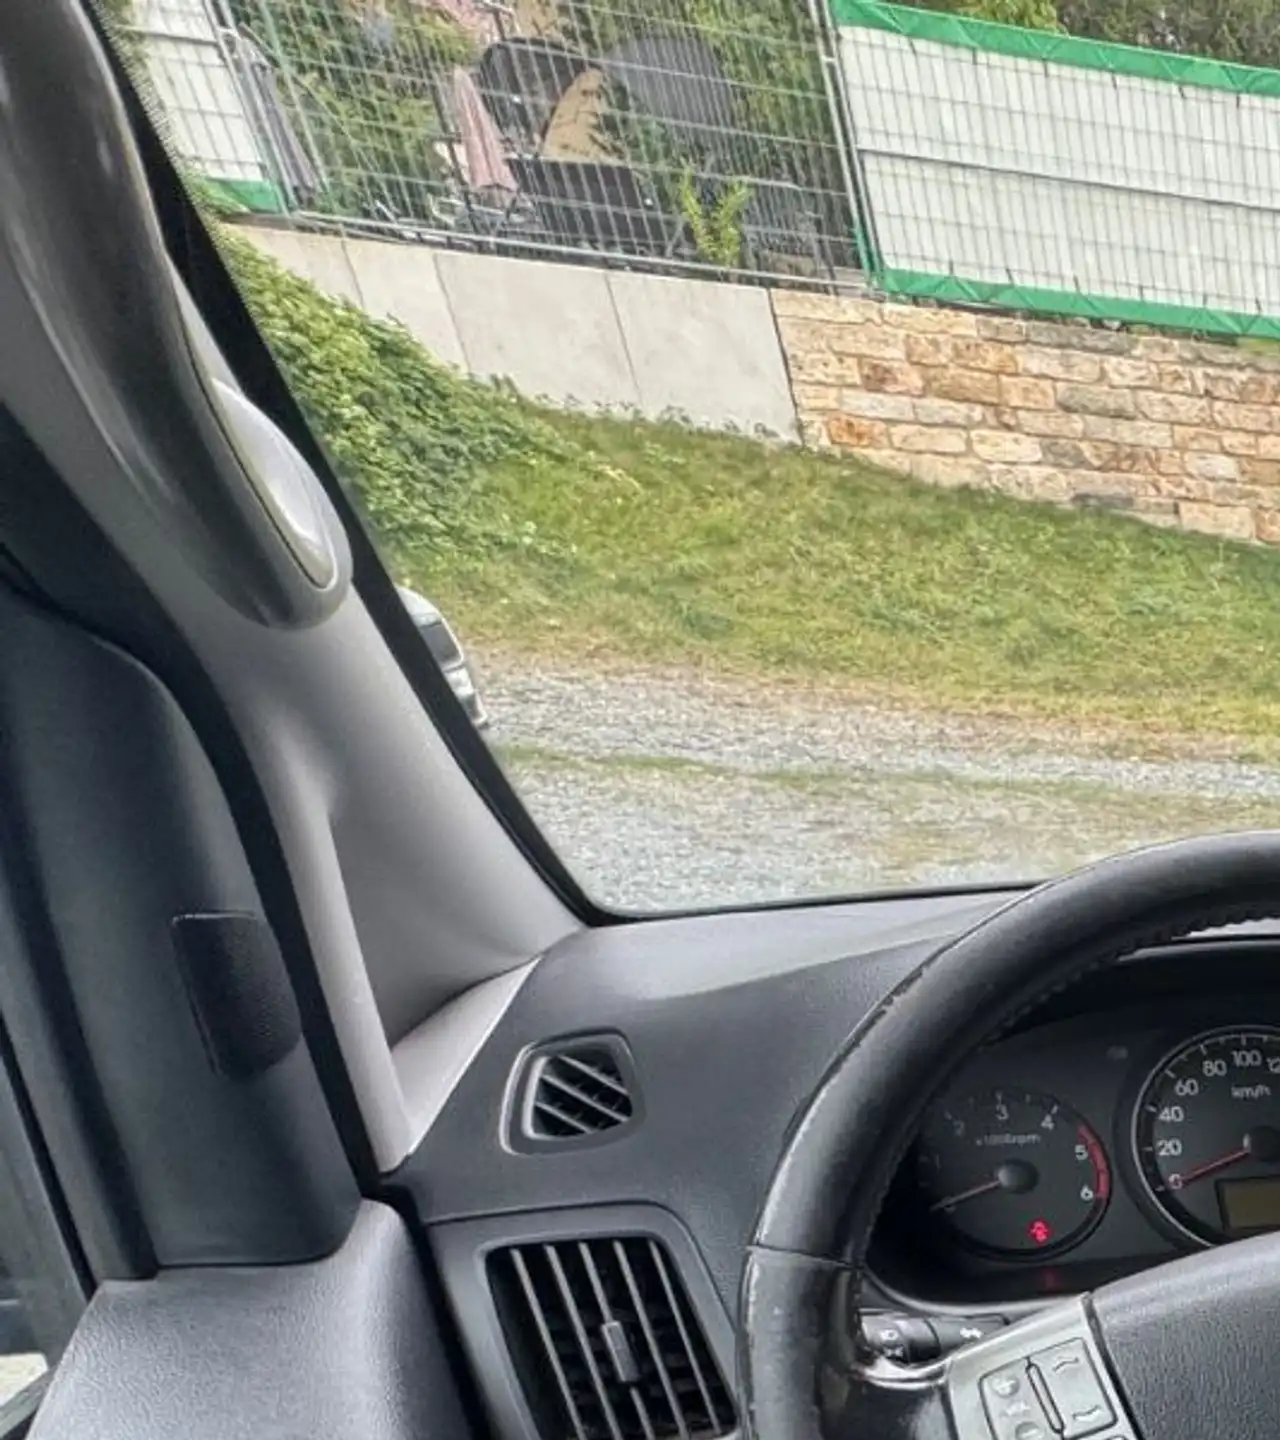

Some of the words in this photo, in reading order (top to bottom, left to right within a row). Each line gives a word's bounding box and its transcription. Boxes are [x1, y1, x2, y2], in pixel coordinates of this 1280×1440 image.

[1231, 1050, 1262, 1068] 100
[1202, 1060, 1227, 1078] 80
[1174, 1079, 1199, 1096] 60
[1231, 1084, 1271, 1099] km/h
[995, 1103, 1009, 1121] 3
[1158, 1106, 1184, 1123] 40
[953, 1120, 965, 1137] 2
[1040, 1113, 1055, 1131] 4
[1074, 1144, 1088, 1161] 5
[1156, 1139, 1183, 1156] 20
[1168, 1173, 1183, 1190] 0
[1080, 1184, 1094, 1202] 6
